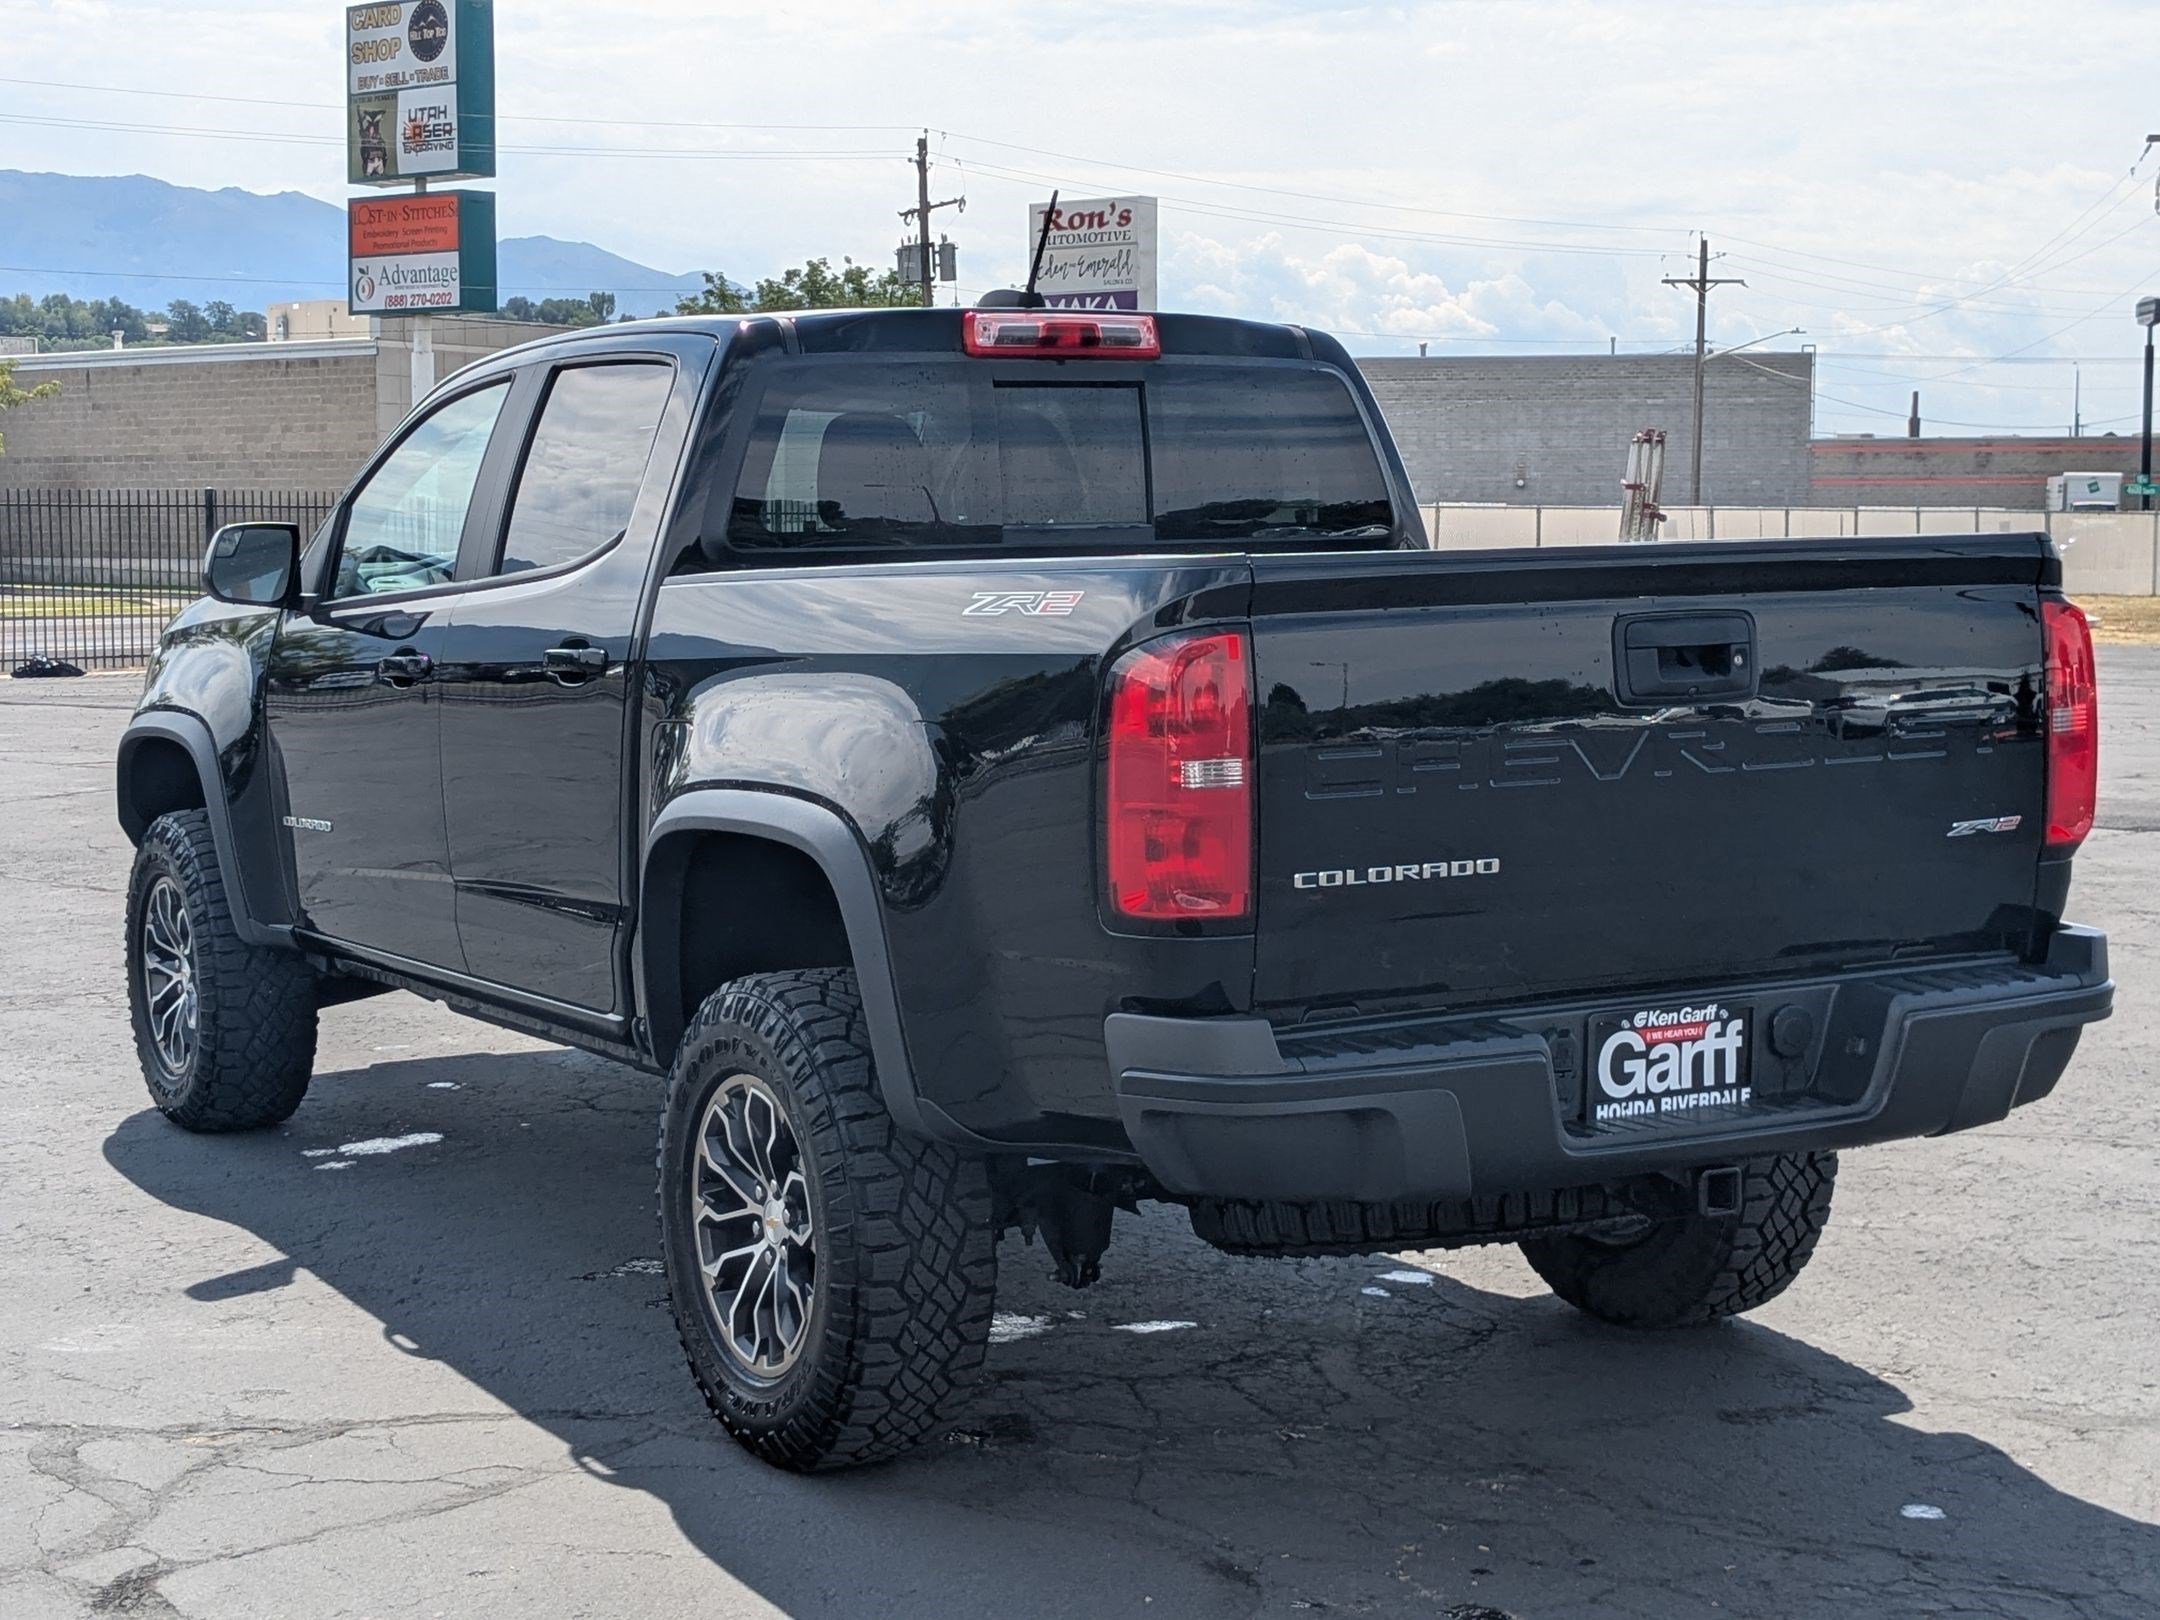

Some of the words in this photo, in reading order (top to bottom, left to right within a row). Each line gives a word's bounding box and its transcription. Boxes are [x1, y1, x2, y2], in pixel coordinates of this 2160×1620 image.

[352, 4, 402, 31] CARD
[352, 37, 402, 64] SHOP
[357, 75, 379, 90] BUY
[385, 71, 409, 87] SELL
[415, 66, 449, 83] TRADE
[408, 105, 447, 122] UTAH
[403, 122, 453, 140] LASER
[1037, 201, 1132, 232] Ron's
[1040, 229, 1132, 246] UTOMOTIVE
[379, 264, 458, 288] Advantage
[384, 295, 408, 308] (888)
[409, 292, 452, 306] 270-0202
[962, 590, 1085, 617] ZR2
[1946, 815, 2022, 837] ZR2
[1293, 858, 1500, 889] COLORADO
[1648, 1009, 1681, 1027] Ken
[1679, 1004, 1718, 1024] Garff
[1664, 1030, 1683, 1039] HEAR
[1683, 1027, 1698, 1037] YOU
[1598, 1019, 1743, 1098] Garff
